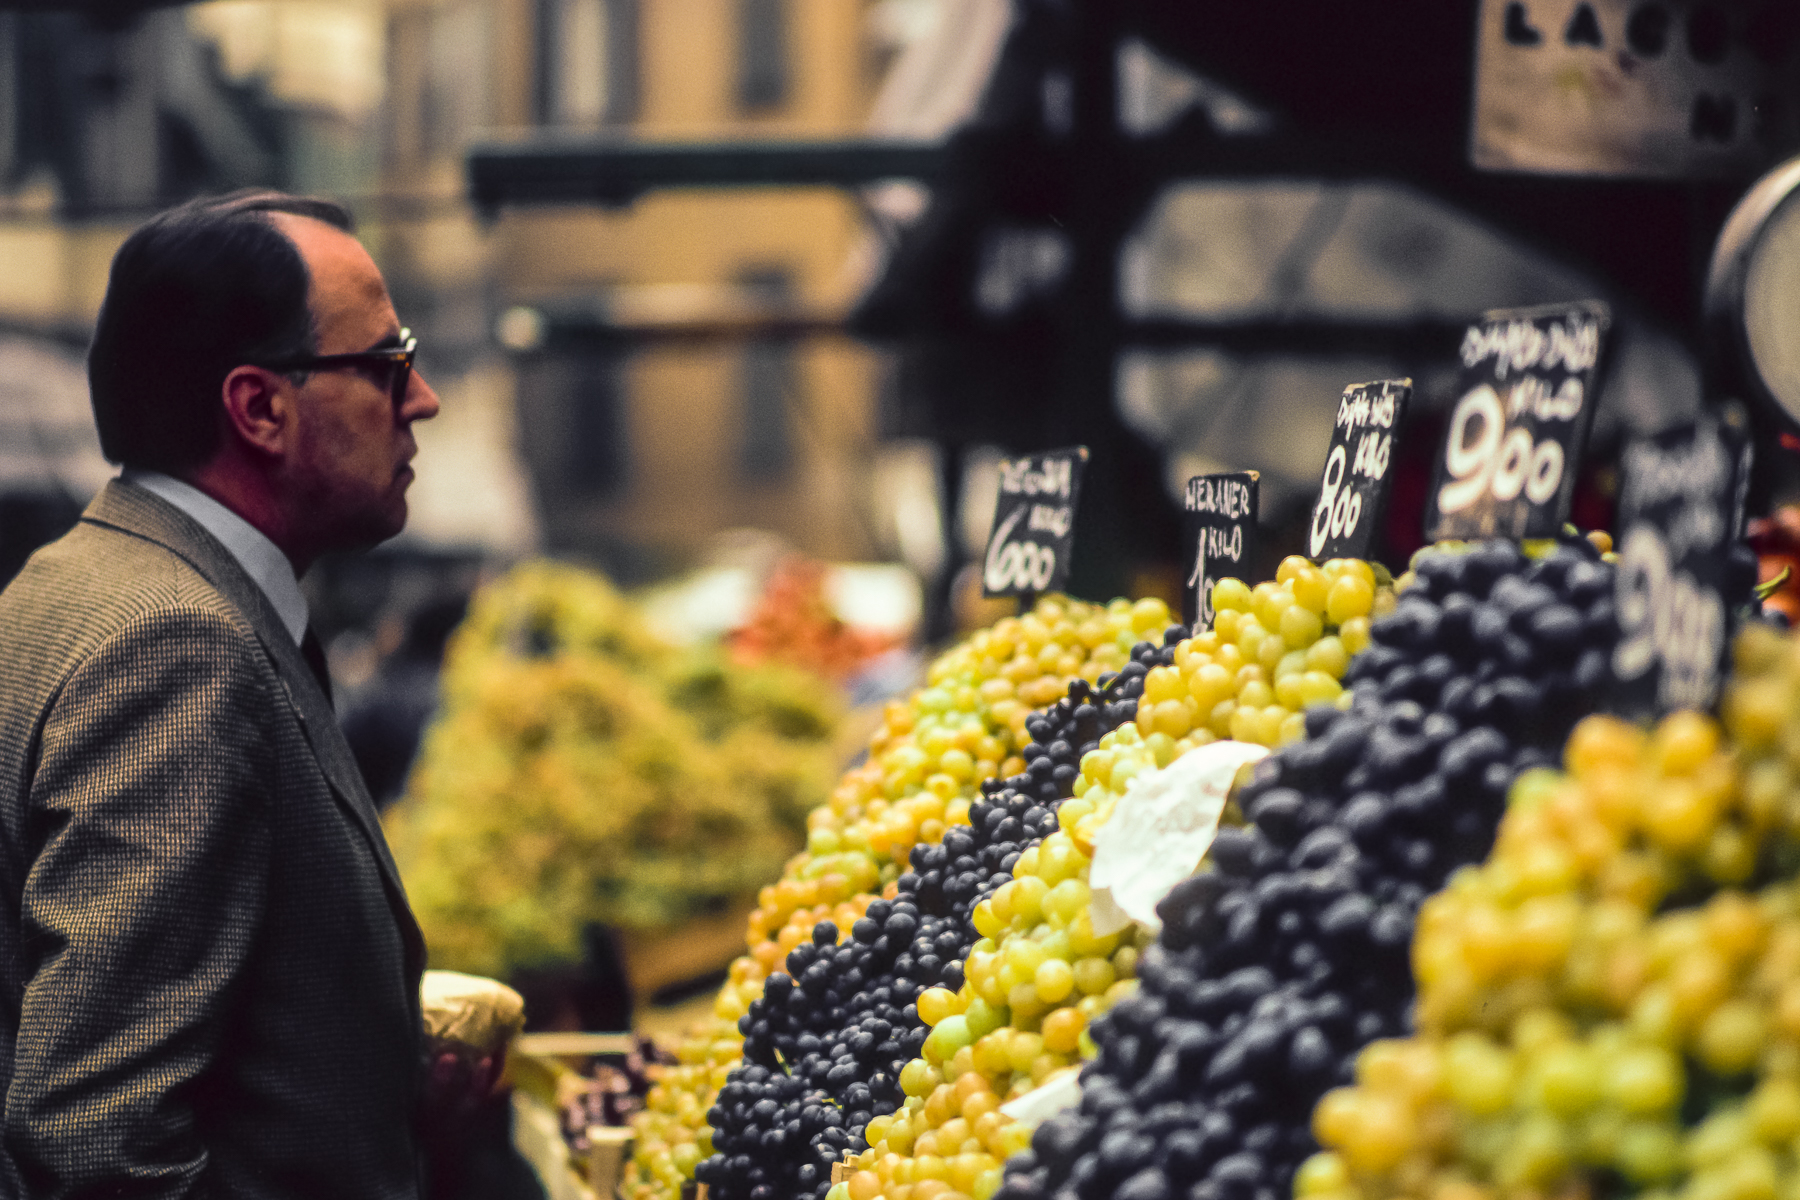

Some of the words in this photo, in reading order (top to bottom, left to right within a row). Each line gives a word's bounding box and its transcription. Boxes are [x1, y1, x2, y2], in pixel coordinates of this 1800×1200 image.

[1438, 383, 1564, 514] 900
[985, 502, 1056, 592] 600
[1208, 526, 1242, 562] KILO
[1310, 444, 1362, 557] 800
